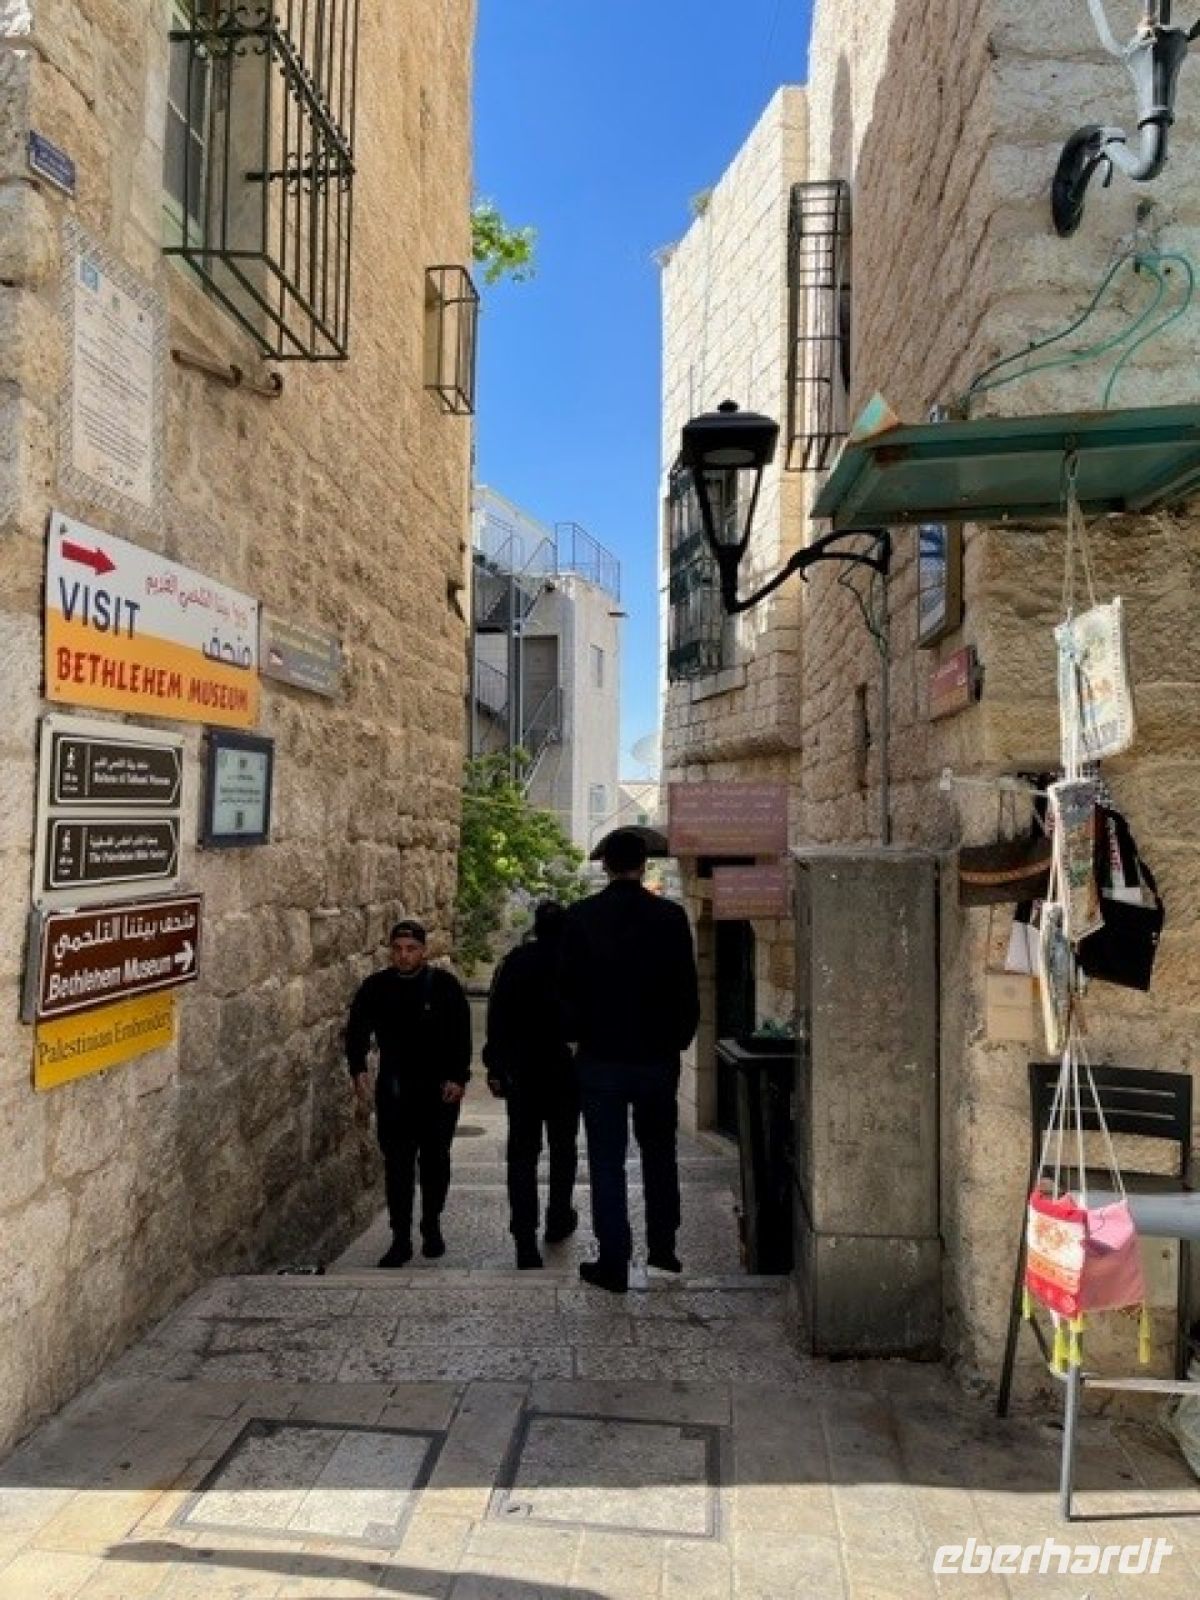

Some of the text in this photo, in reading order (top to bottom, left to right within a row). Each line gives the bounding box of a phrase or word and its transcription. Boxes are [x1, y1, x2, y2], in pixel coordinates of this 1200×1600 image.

[58, 577, 141, 640] VISIT
[202, 626, 251, 671] متحف
[57, 646, 248, 712] BETHLEHEM MUSEUM
[54, 910, 196, 968] متحف بيتنا التلحمي
[49, 956, 172, 1001] Bethlehem Museum
[37, 1026, 114, 1066] Palestinian
